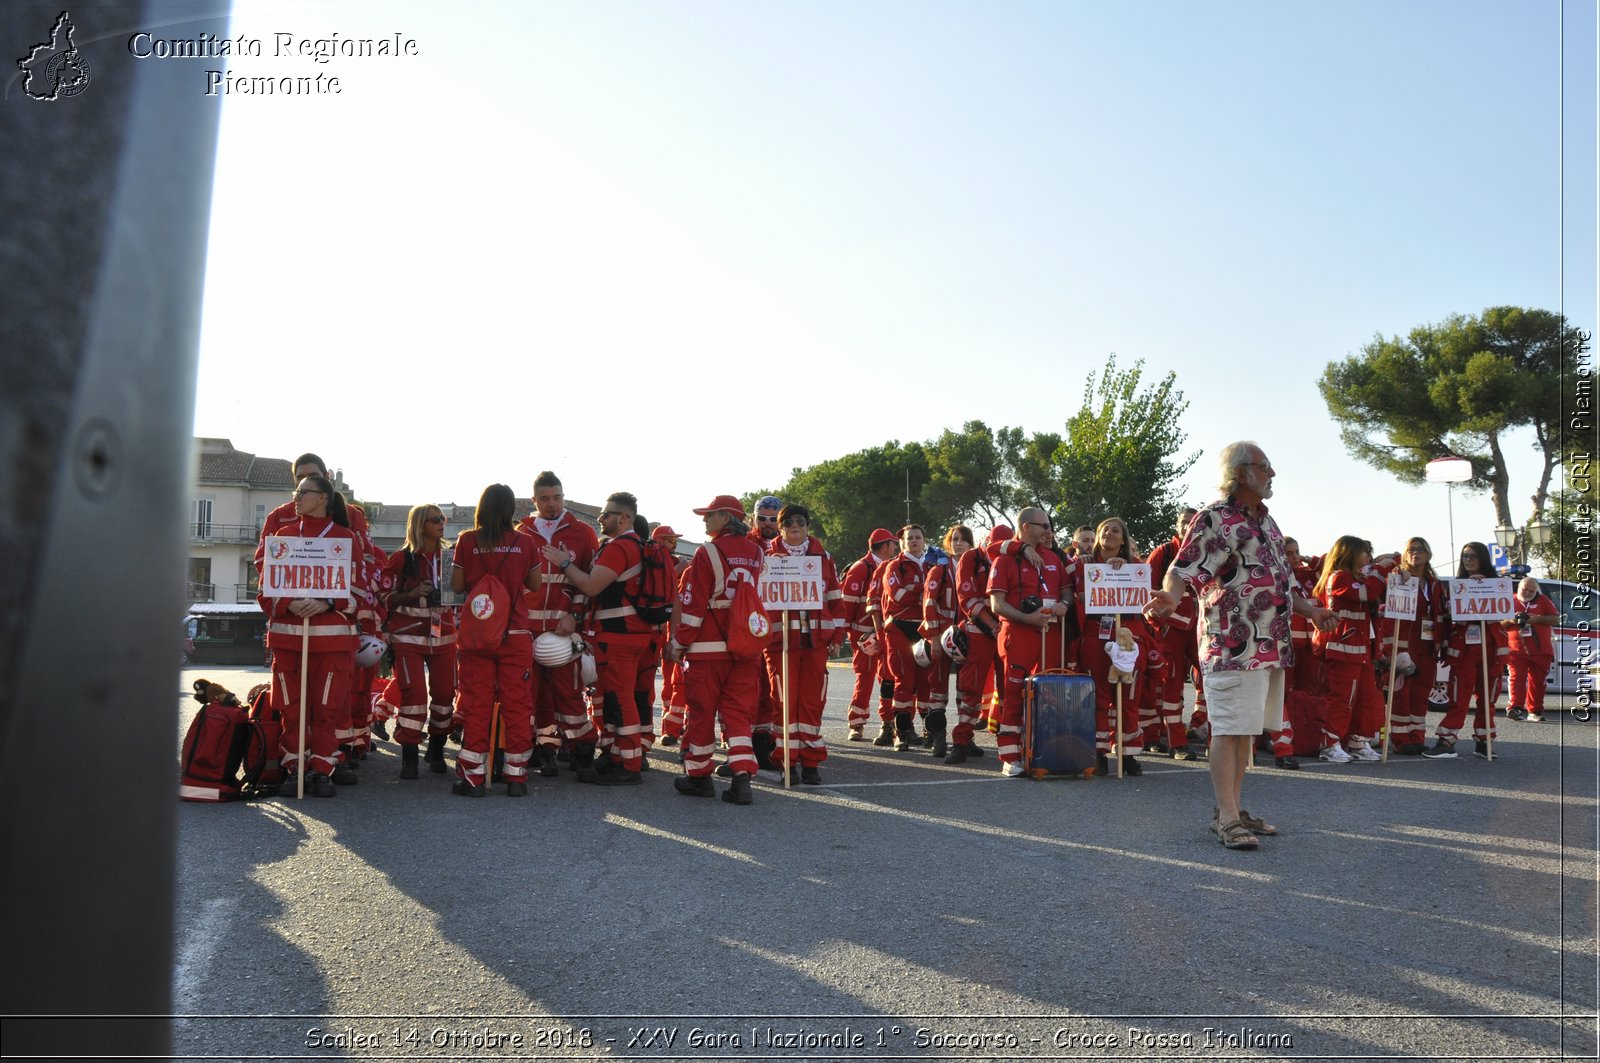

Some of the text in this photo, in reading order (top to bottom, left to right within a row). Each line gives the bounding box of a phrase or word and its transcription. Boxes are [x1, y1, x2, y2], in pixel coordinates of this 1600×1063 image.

[270, 564, 346, 590] UMBRIA
[760, 580, 820, 604] IGURIA
[1089, 587, 1149, 607] ABRUZZO
[1455, 597, 1511, 615] LAZIO
